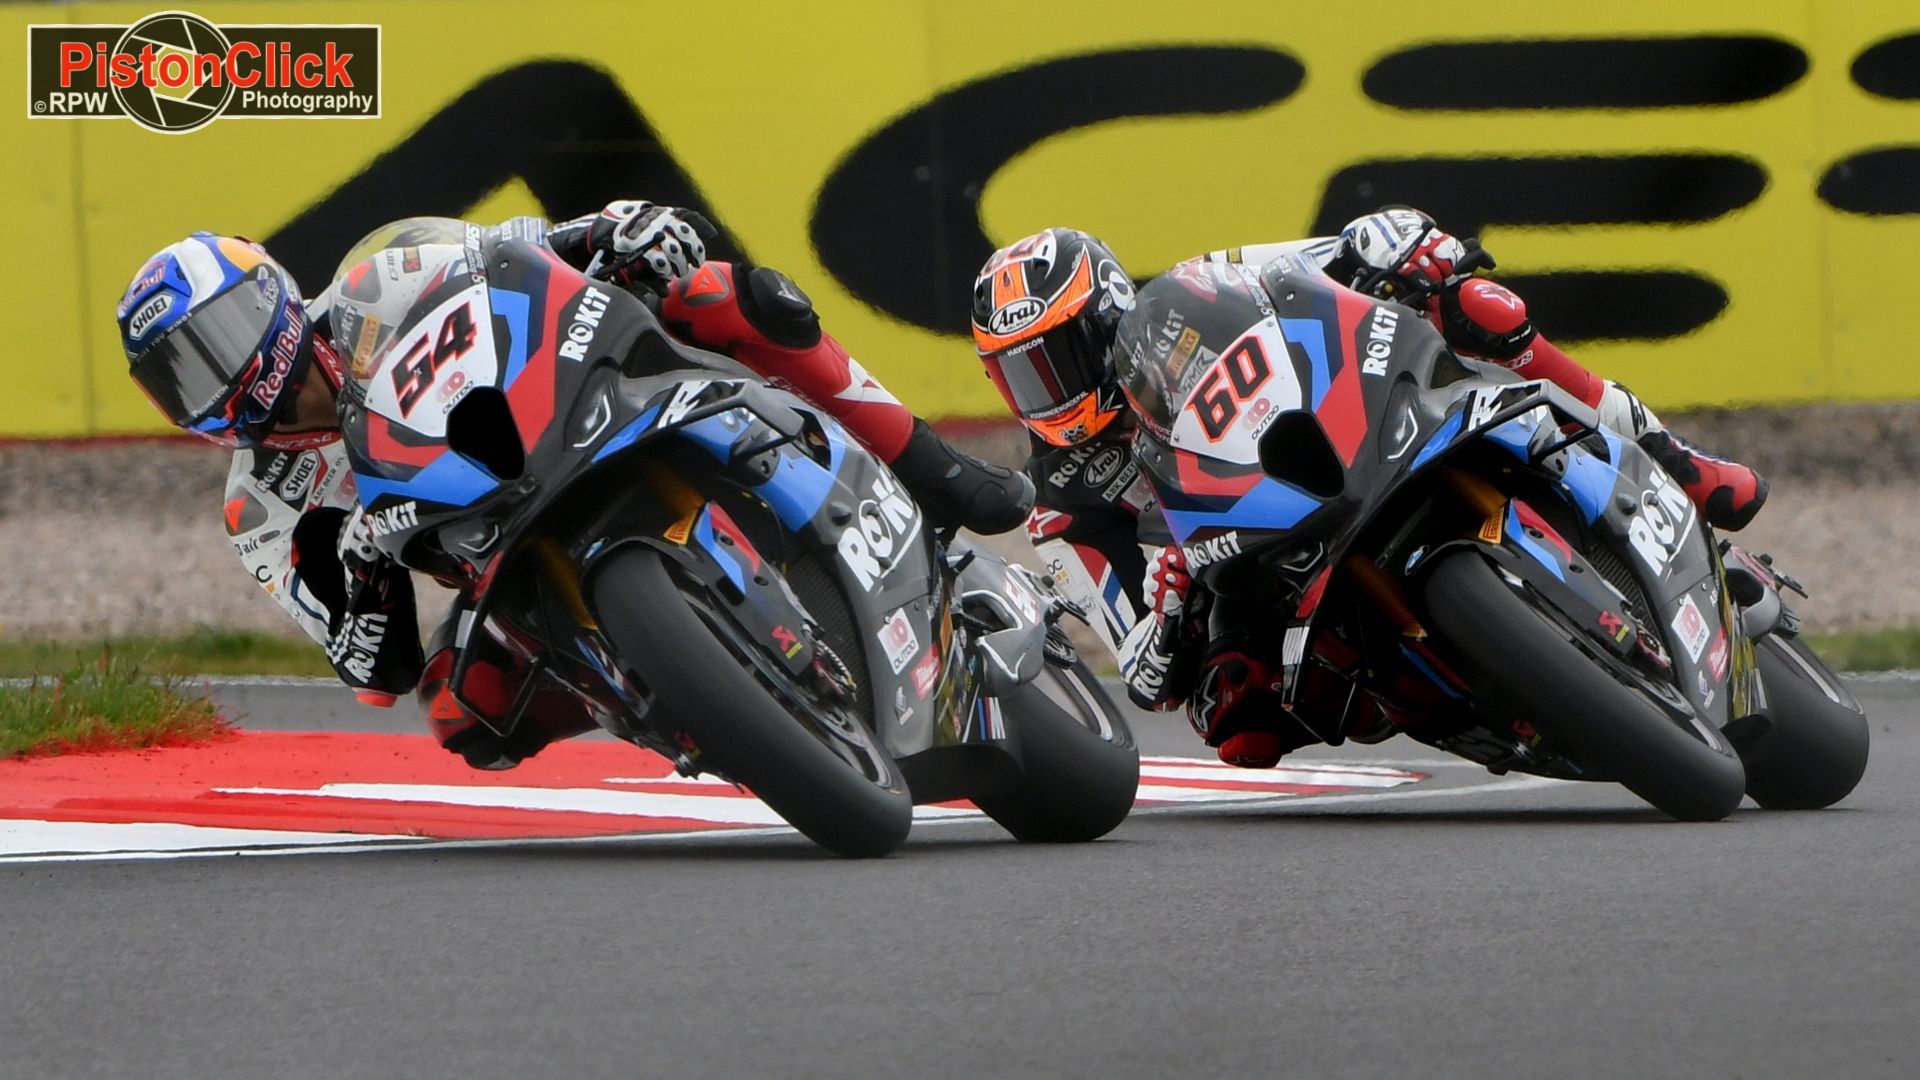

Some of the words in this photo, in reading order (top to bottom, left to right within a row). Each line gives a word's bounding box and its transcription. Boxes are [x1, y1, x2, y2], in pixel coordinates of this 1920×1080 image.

[255, 35, 1920, 340] ACE
[132, 297, 168, 335] SHOEI
[994, 300, 1036, 332] Arai
[251, 350, 289, 411] Red
[276, 304, 304, 362] Bull
[391, 300, 478, 420] 54
[443, 380, 474, 415] OUTDO
[1185, 335, 1274, 443] 60
[1251, 405, 1280, 440] OUTDO
[286, 457, 315, 494] SHOEI
[1091, 450, 1119, 484] Arai
